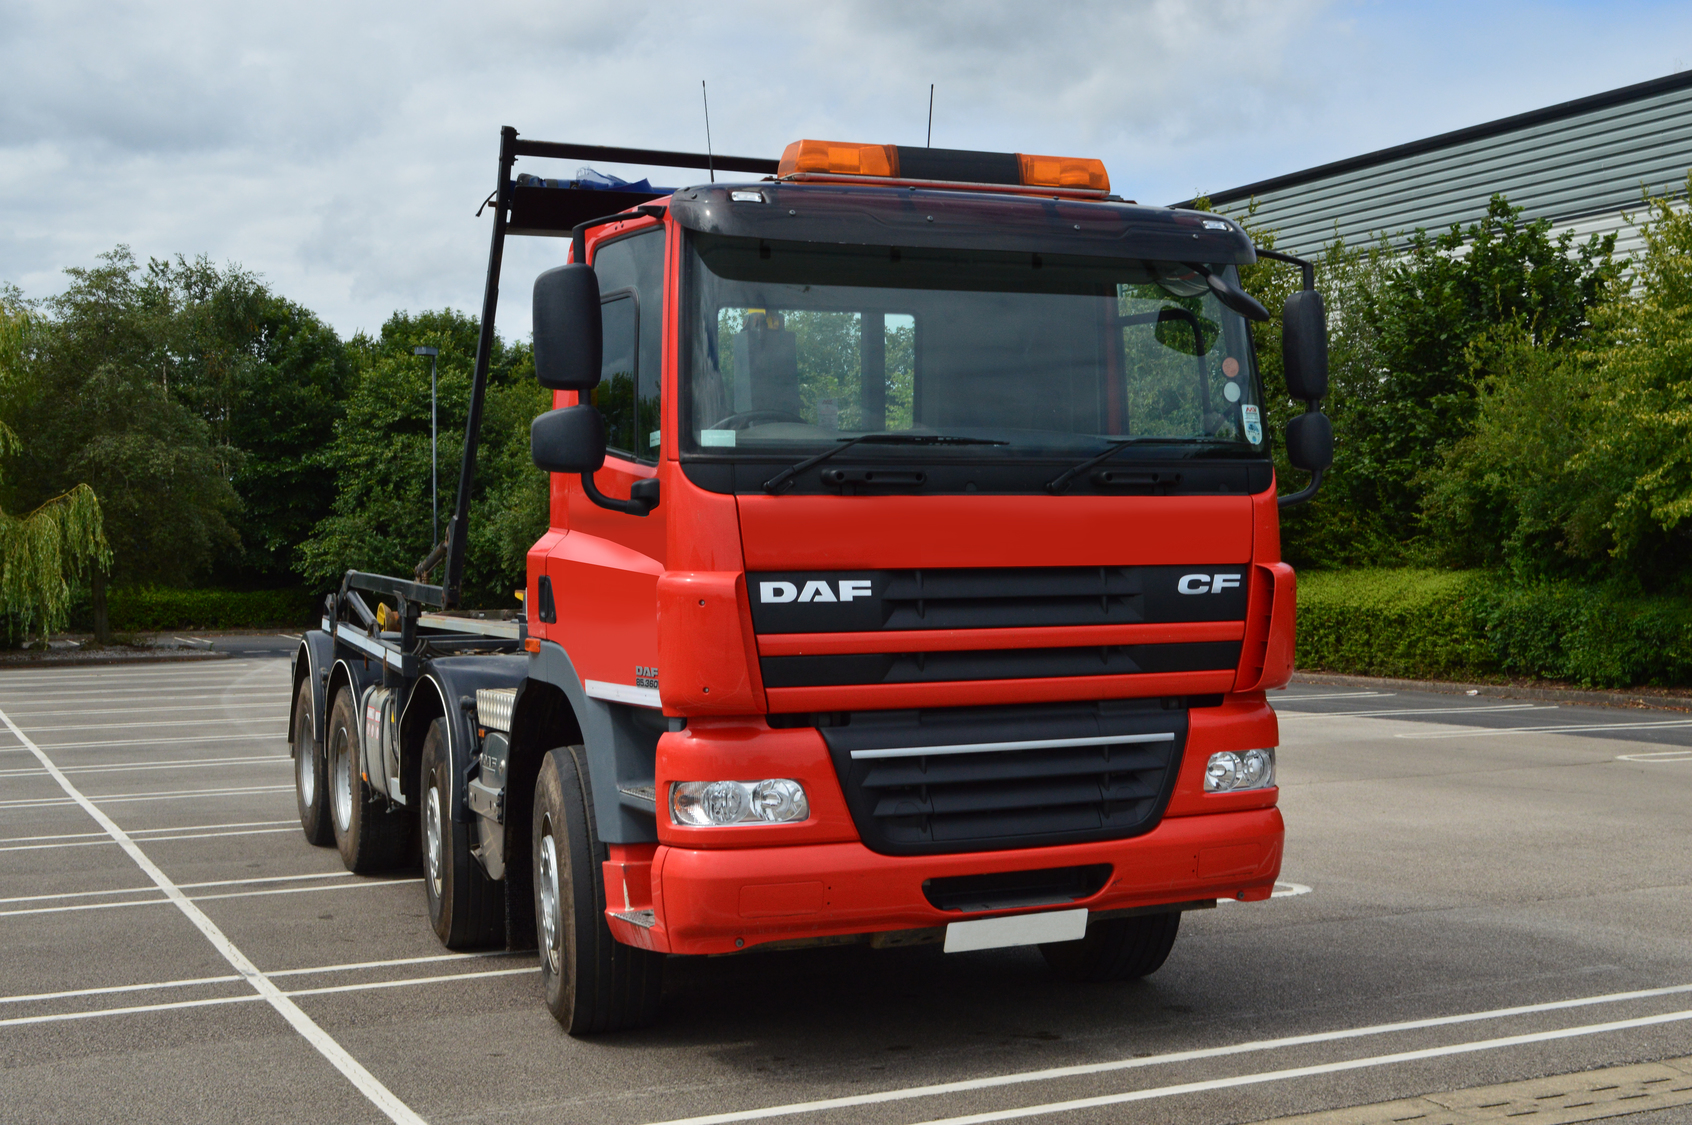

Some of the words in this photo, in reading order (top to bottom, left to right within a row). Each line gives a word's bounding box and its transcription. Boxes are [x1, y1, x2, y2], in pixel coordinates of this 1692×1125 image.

[760, 580, 872, 603] DAF
[1178, 574, 1241, 595] CF
[636, 665, 658, 677] DAF
